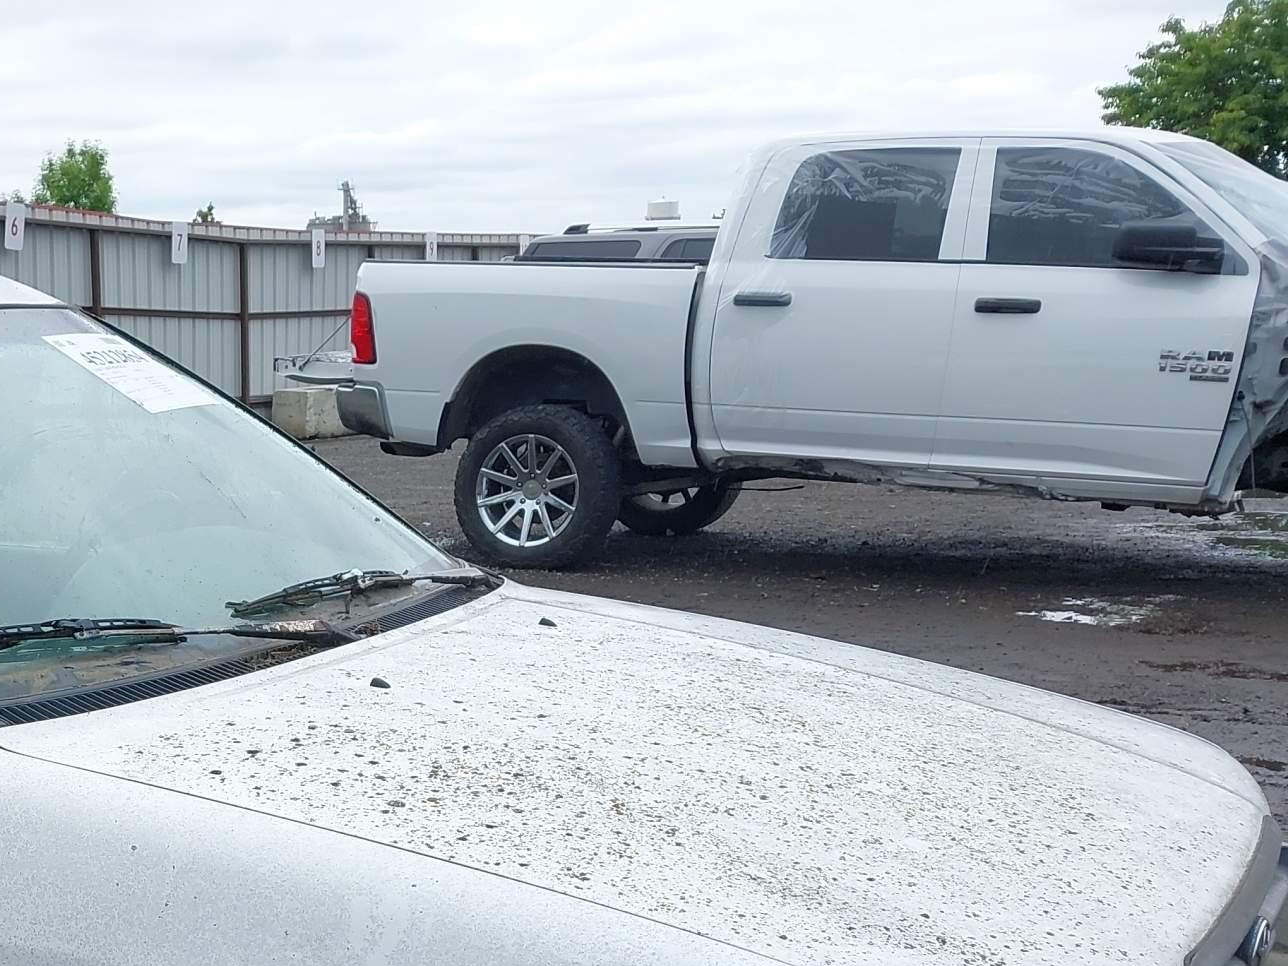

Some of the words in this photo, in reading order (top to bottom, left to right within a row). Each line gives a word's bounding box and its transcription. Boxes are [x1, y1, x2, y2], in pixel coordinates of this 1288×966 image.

[11, 216, 18, 237] 6
[176, 233, 183, 252] 7
[316, 240, 322, 257] 8
[1159, 350, 1235, 362] RAM
[1158, 361, 1232, 375] 1500
